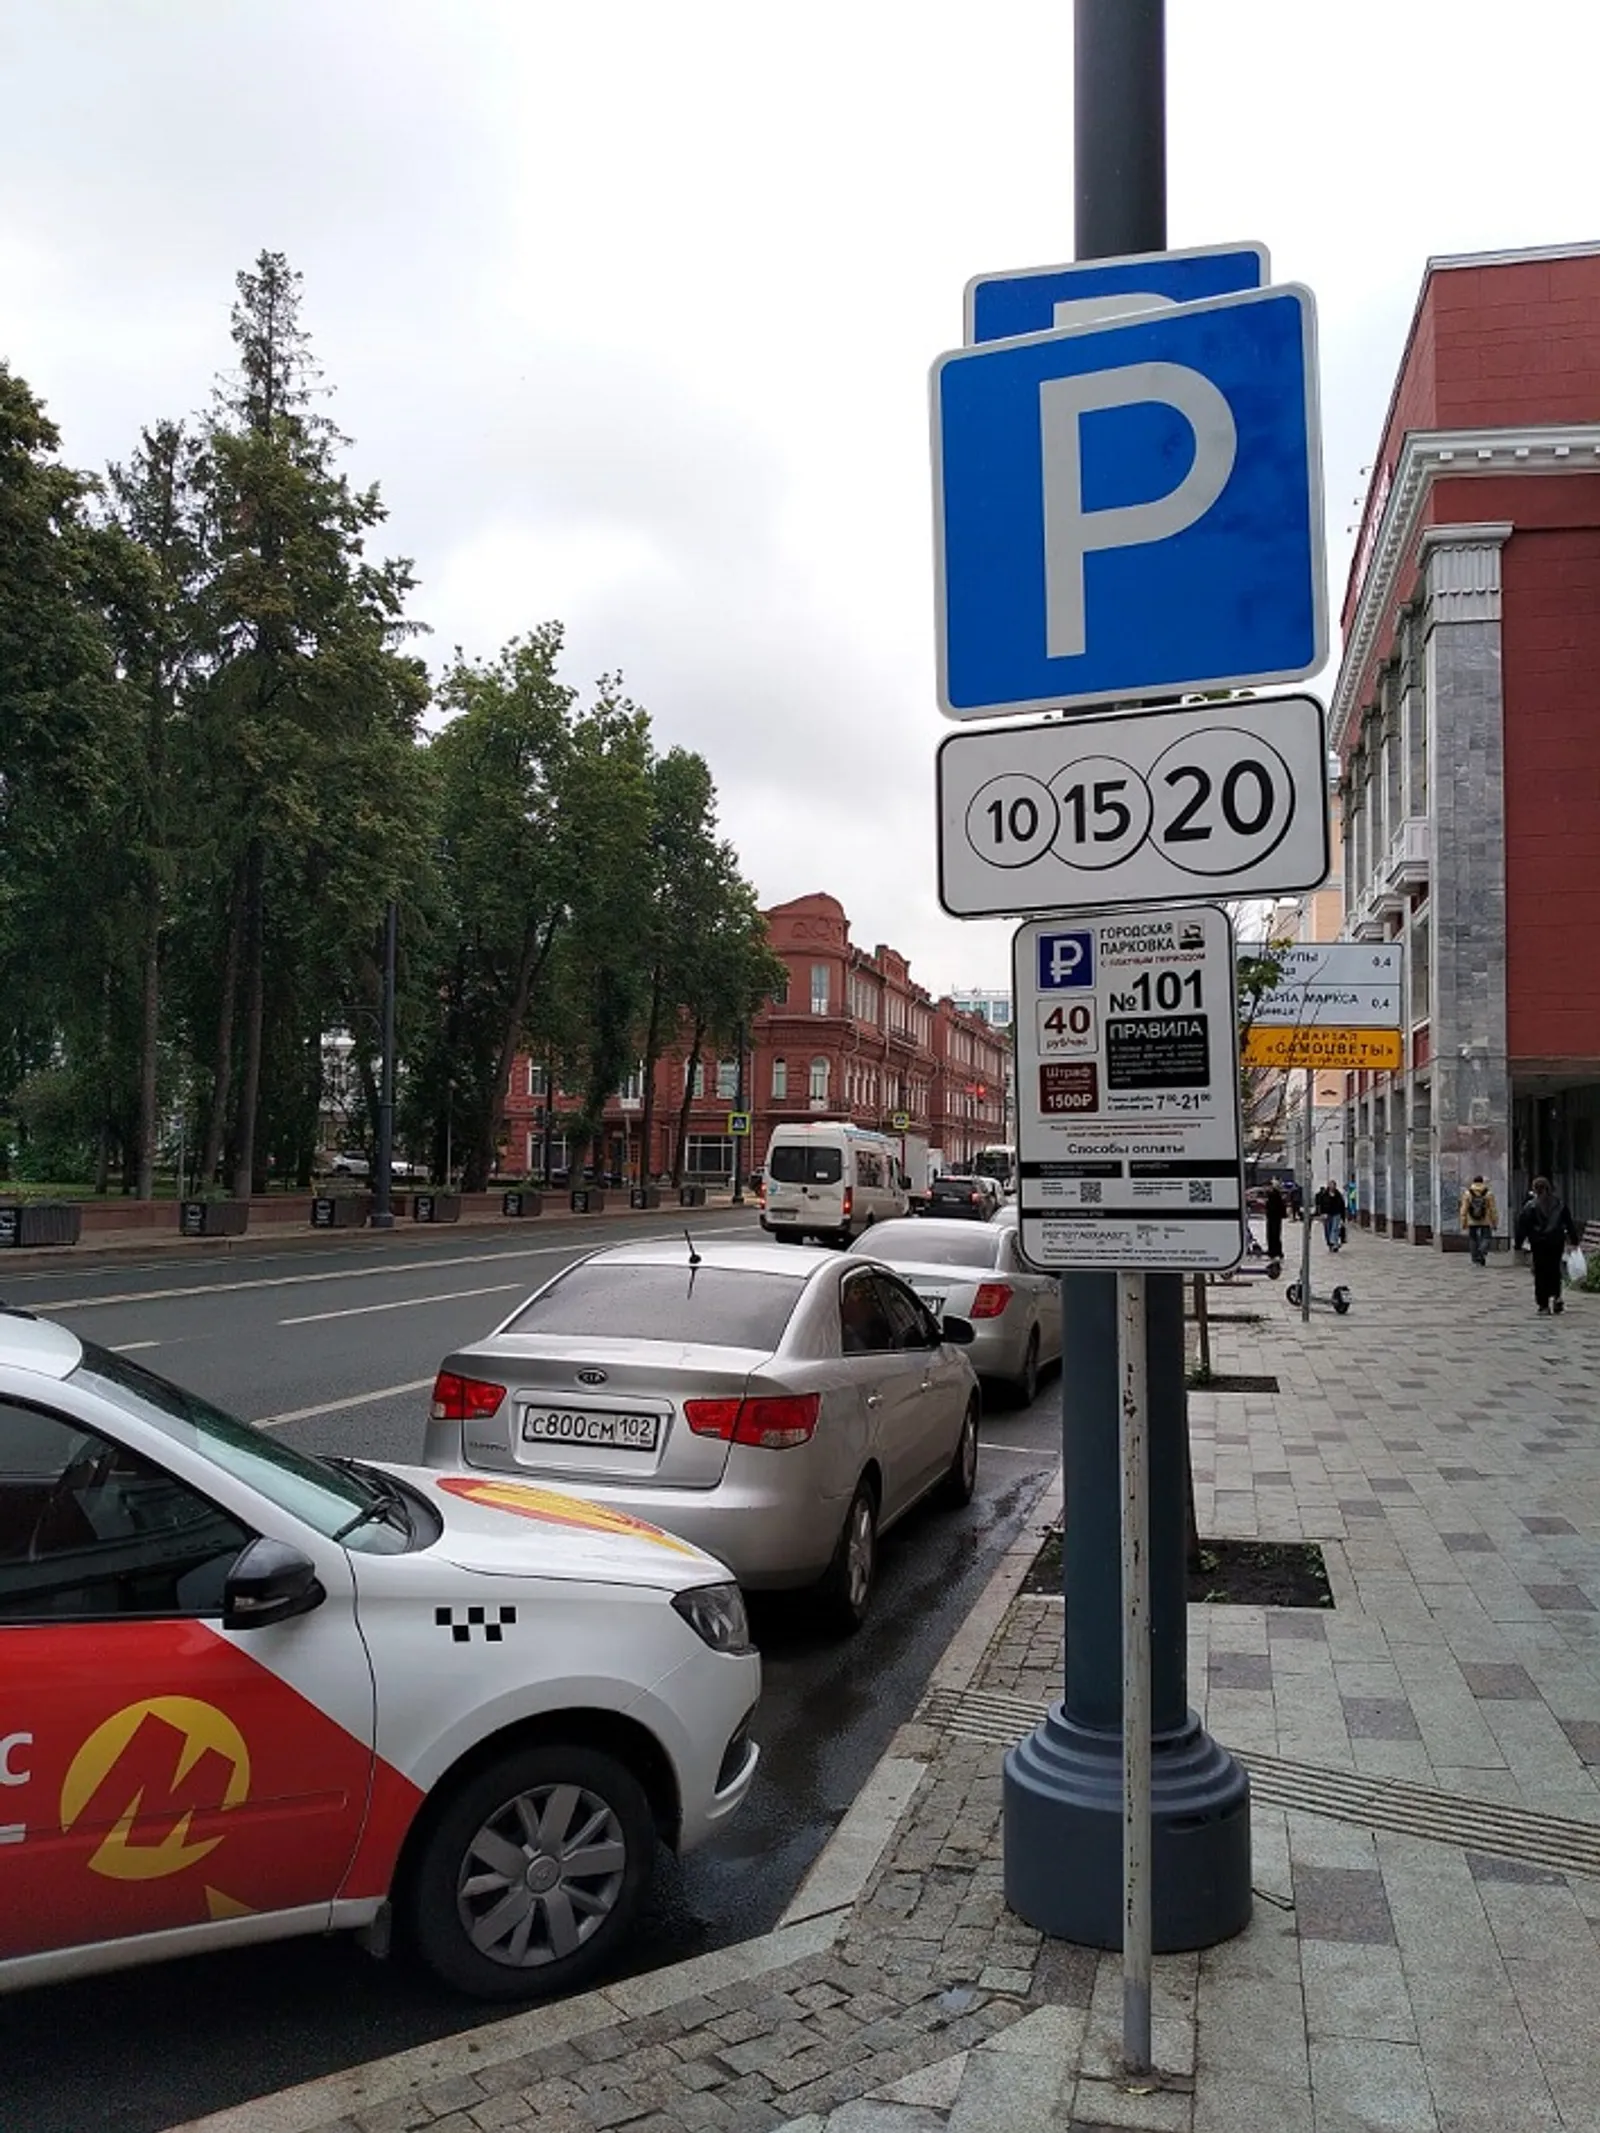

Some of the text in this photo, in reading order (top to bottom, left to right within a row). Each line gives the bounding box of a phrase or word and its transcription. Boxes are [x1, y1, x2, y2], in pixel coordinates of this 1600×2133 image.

[1039, 361, 1238, 659] P
[987, 758, 1275, 843] 10 15 20
[1100, 922, 1174, 940] ГОРОДСКАЯ
[1100, 937, 1176, 955] ПАРКОВКА
[1372, 956, 1391, 968] 0,4
[1371, 998, 1390, 1009] 0,4
[1044, 1005, 1091, 1035] 40
[1109, 1021, 1204, 1040] ПРАВИЛА
[1265, 1042, 1394, 1057] «САМОЦВЕТЫ»
[1046, 1064, 1091, 1079] Штраф
[1067, 1143, 1185, 1155] Способы оплаты
[532, 1414, 650, 1440] С800СМ 102
